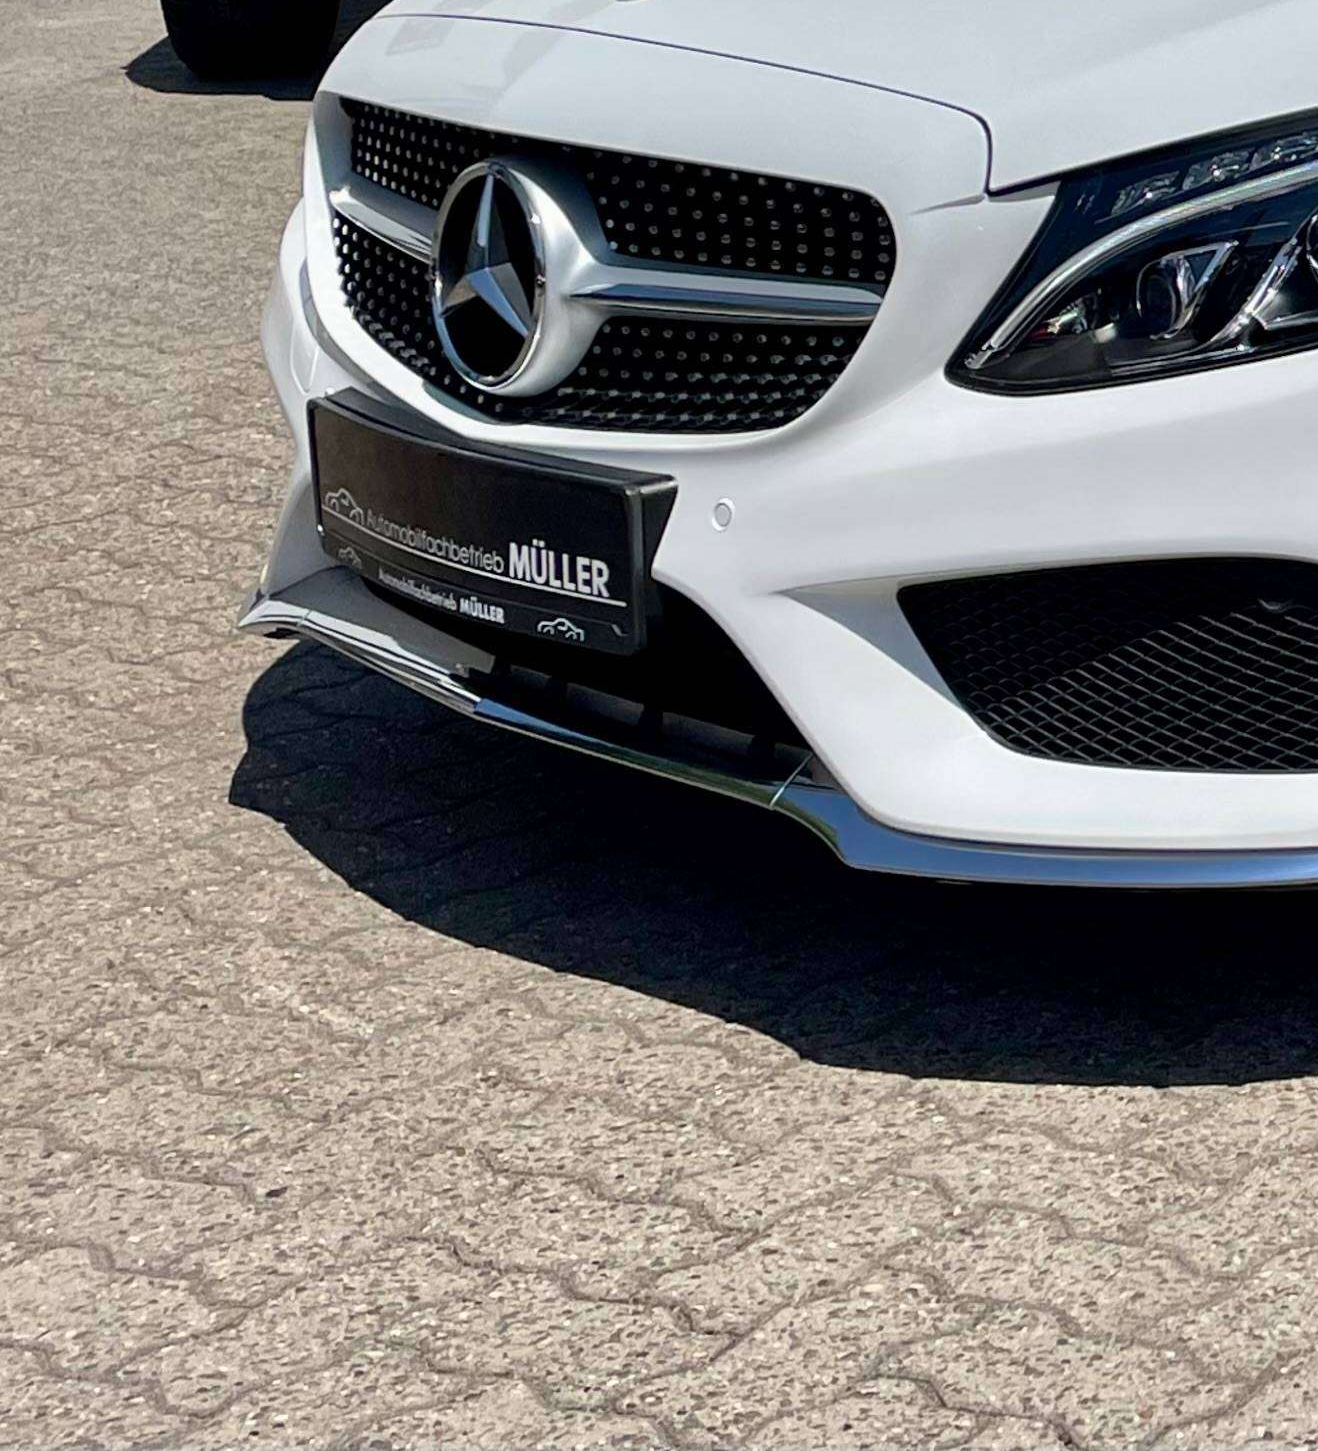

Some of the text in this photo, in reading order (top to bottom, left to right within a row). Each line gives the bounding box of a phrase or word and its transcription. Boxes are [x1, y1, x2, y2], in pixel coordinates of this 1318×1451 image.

[366, 508, 610, 599] Automobilfachbetrieb MÜLLER
[459, 595, 505, 625] MÜLLER
